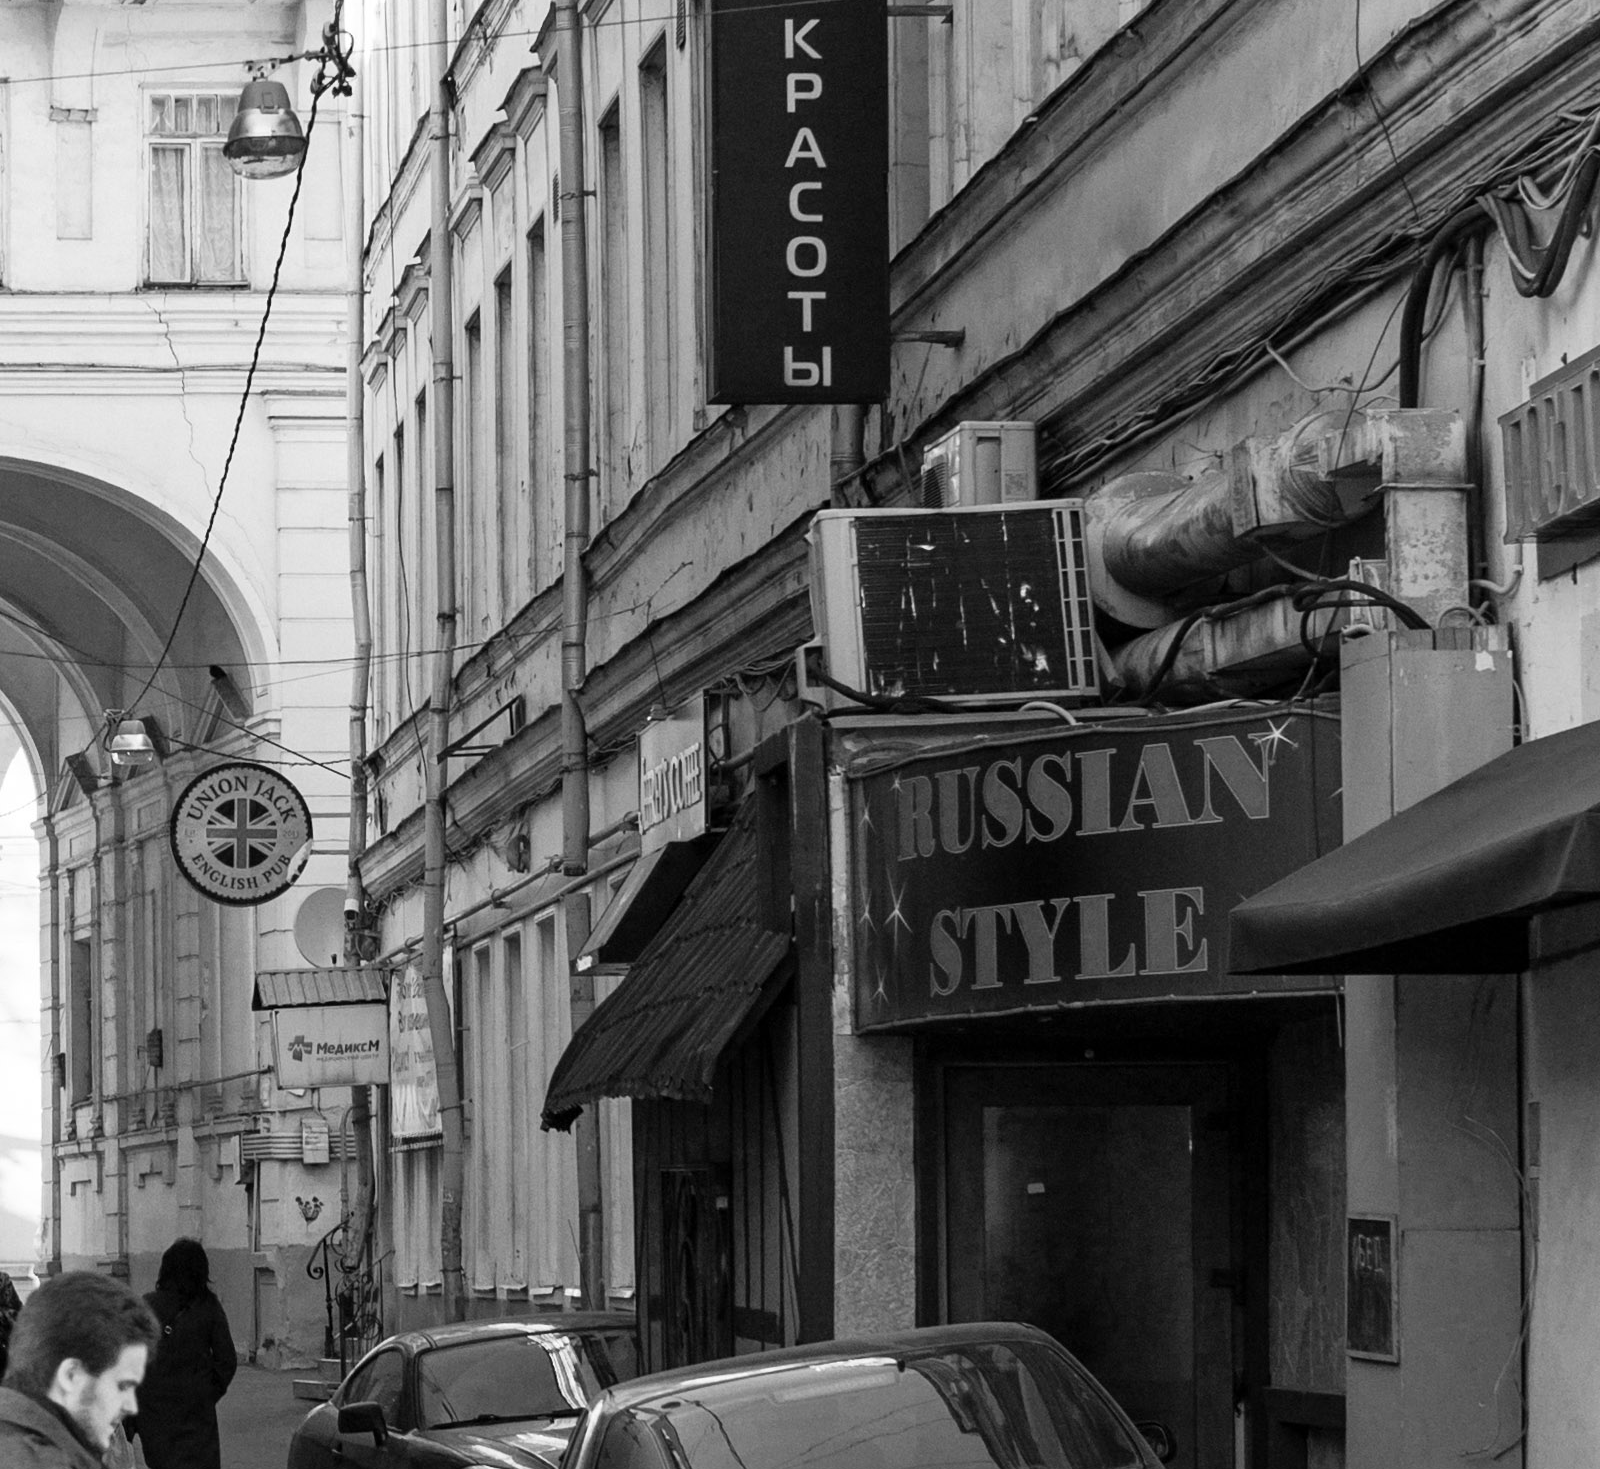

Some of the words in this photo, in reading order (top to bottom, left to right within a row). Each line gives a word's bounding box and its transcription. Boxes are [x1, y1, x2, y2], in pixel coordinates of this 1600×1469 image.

[783, 18, 832, 388] КРАСОТЫ
[186, 775, 248, 821] UNION
[253, 779, 298, 824] JACK
[897, 732, 1271, 862] RUSSIAN
[192, 852, 259, 890] ENGLISH
[262, 854, 291, 884] PUB
[930, 886, 1208, 998] STYLE
